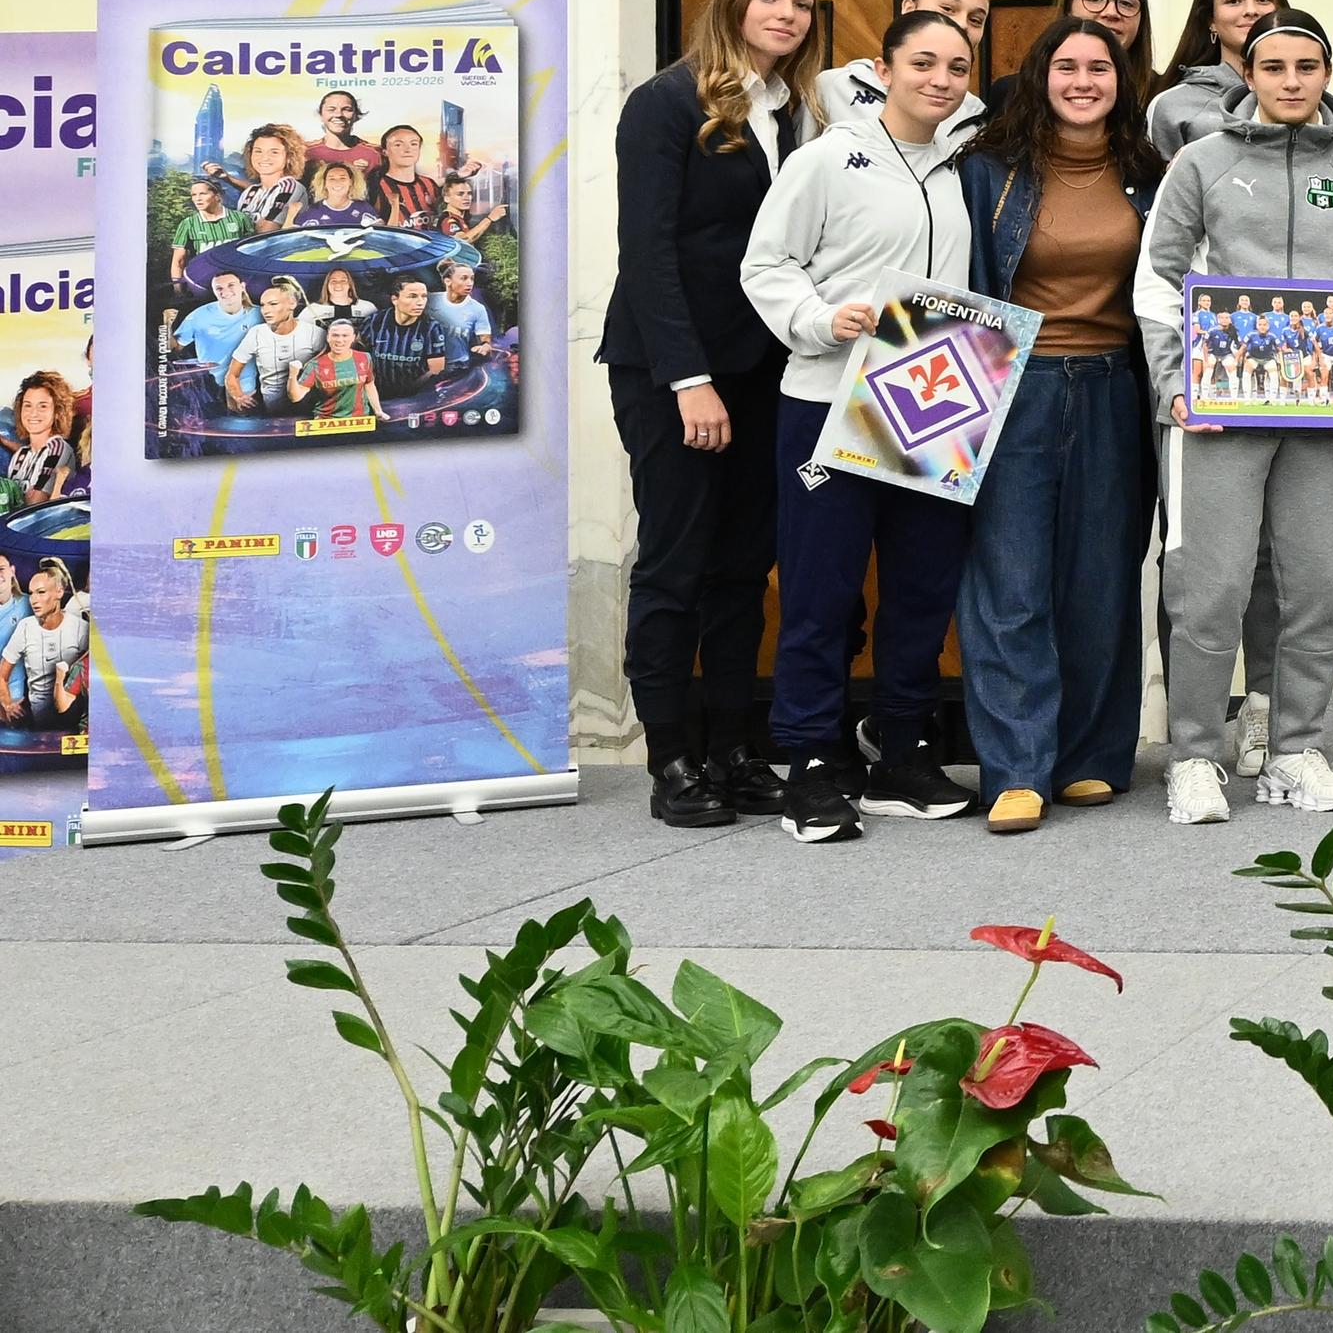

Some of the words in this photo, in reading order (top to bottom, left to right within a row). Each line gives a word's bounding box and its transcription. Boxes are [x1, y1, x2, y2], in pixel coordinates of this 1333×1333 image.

[161, 40, 444, 77] Calciatrici
[316, 77, 376, 88] Figurine
[382, 76, 444, 86] 2025-2026
[911, 291, 1003, 330] FIORENTINA
[319, 417, 372, 429] PANINI
[846, 452, 877, 466] PANINI
[204, 537, 275, 550] PANINI
